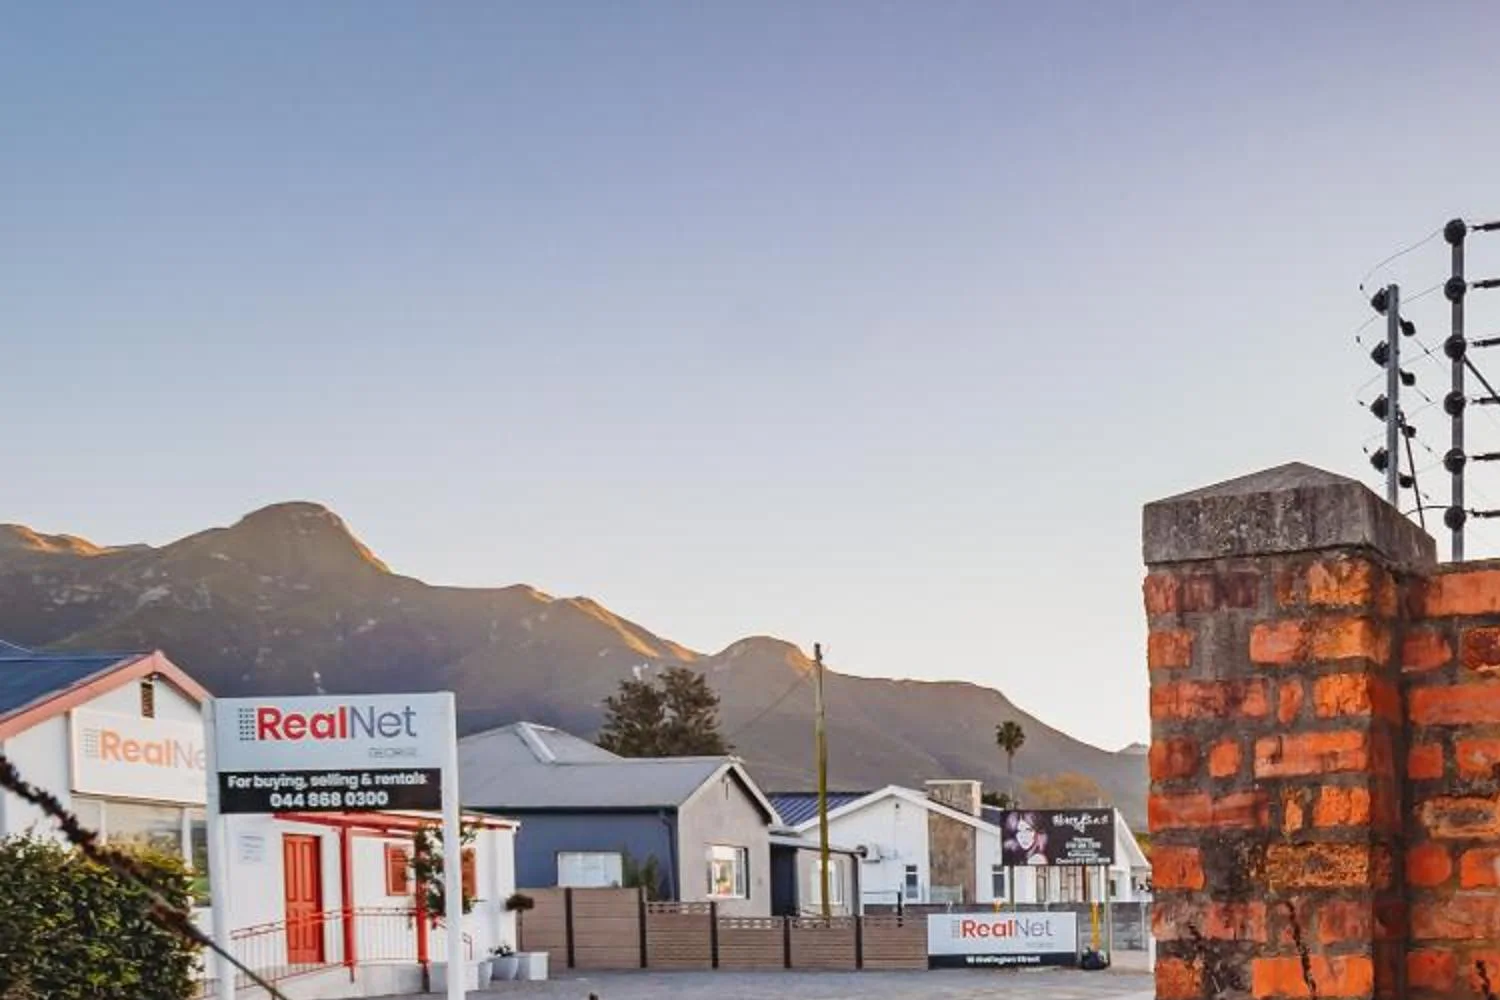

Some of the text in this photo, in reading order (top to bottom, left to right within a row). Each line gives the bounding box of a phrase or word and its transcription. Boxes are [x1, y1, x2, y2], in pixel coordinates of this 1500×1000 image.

[257, 705, 417, 741] RealNet
[100, 731, 206, 770] RealNe
[228, 771, 427, 791] For buying, selling & rentals
[270, 790, 388, 808] 044 868 0300
[961, 918, 1055, 938] RealNet
